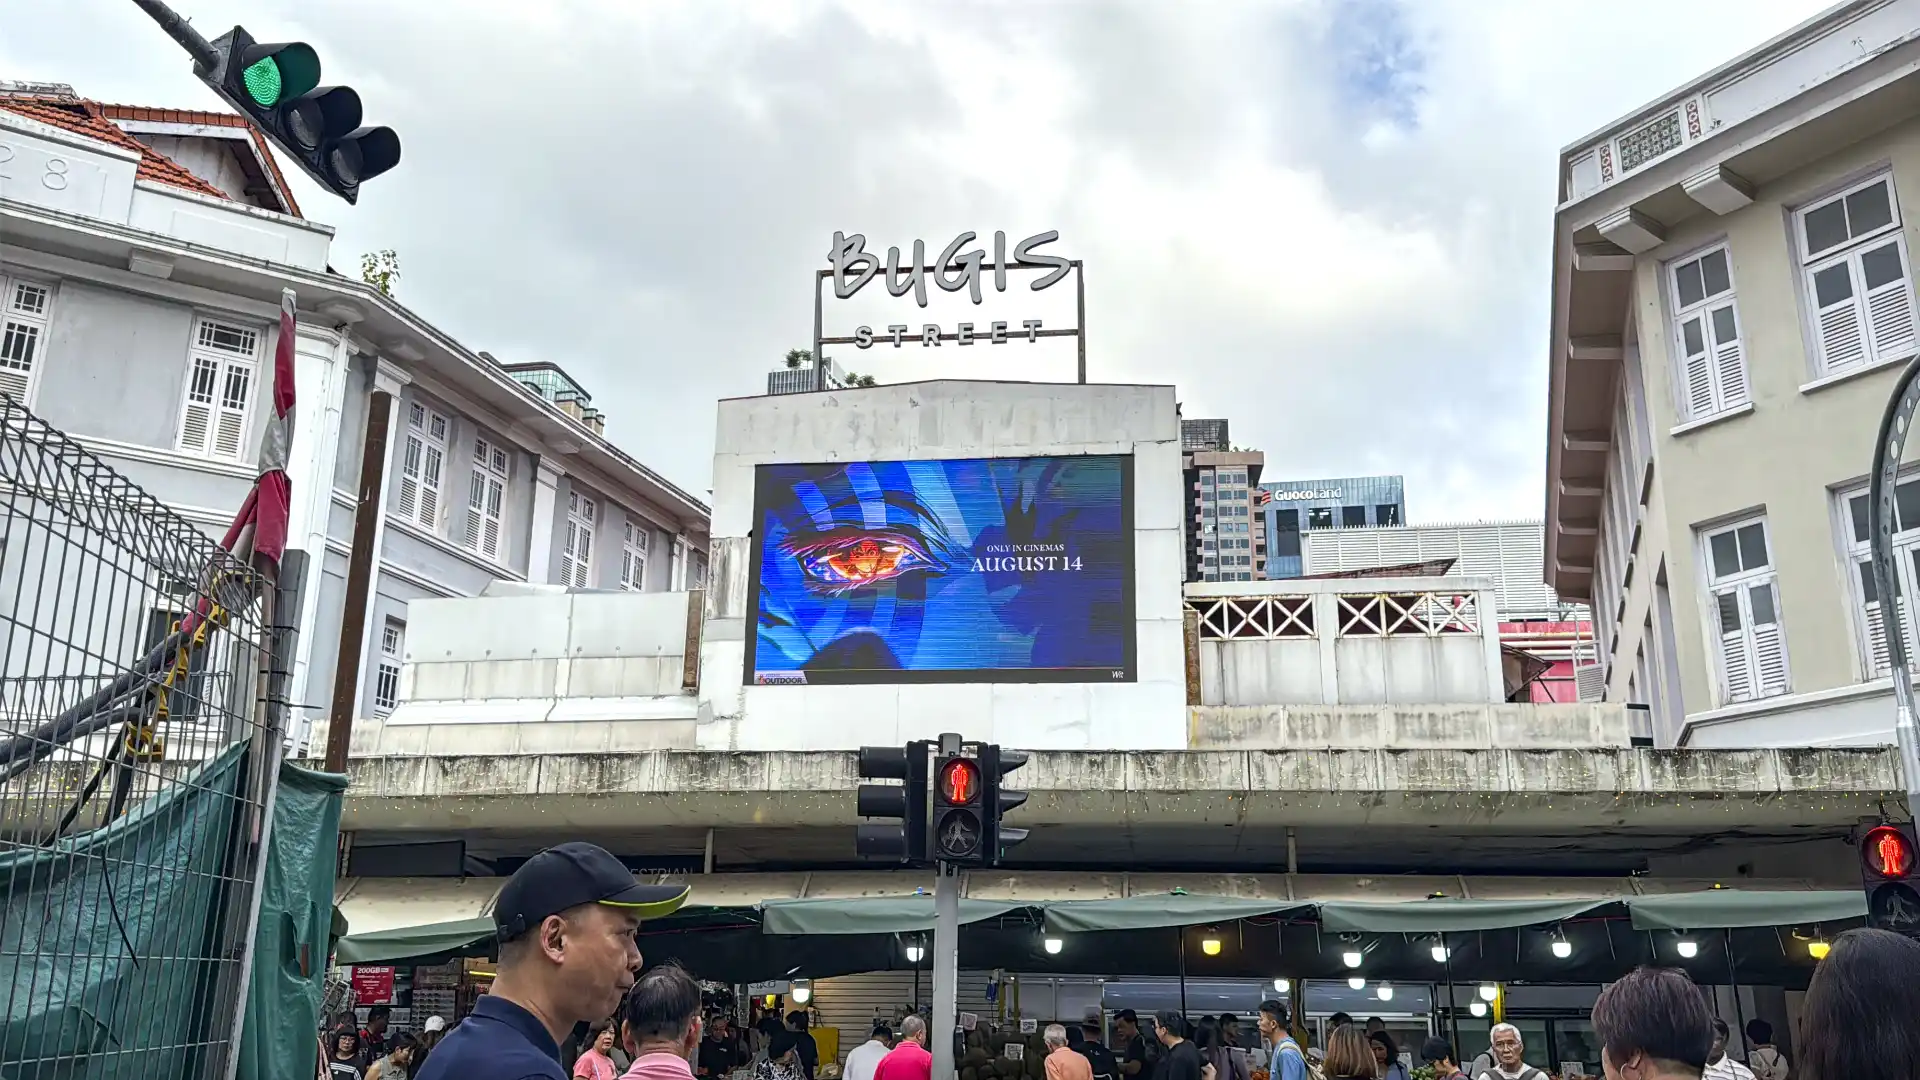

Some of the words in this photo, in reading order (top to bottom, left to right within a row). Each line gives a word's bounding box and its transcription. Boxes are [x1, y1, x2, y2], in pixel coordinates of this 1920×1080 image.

[827, 229, 1072, 309] BUGIS
[855, 319, 1043, 350] STREET
[1274, 487, 1342, 501] GuocoLand
[986, 544, 1011, 553] ONLY
[1012, 544, 1023, 552] IN
[1023, 543, 1065, 552] CINEMAS
[970, 556, 1058, 572] AUGUST
[1062, 556, 1084, 571] 14
[356, 966, 381, 974] 200GB
